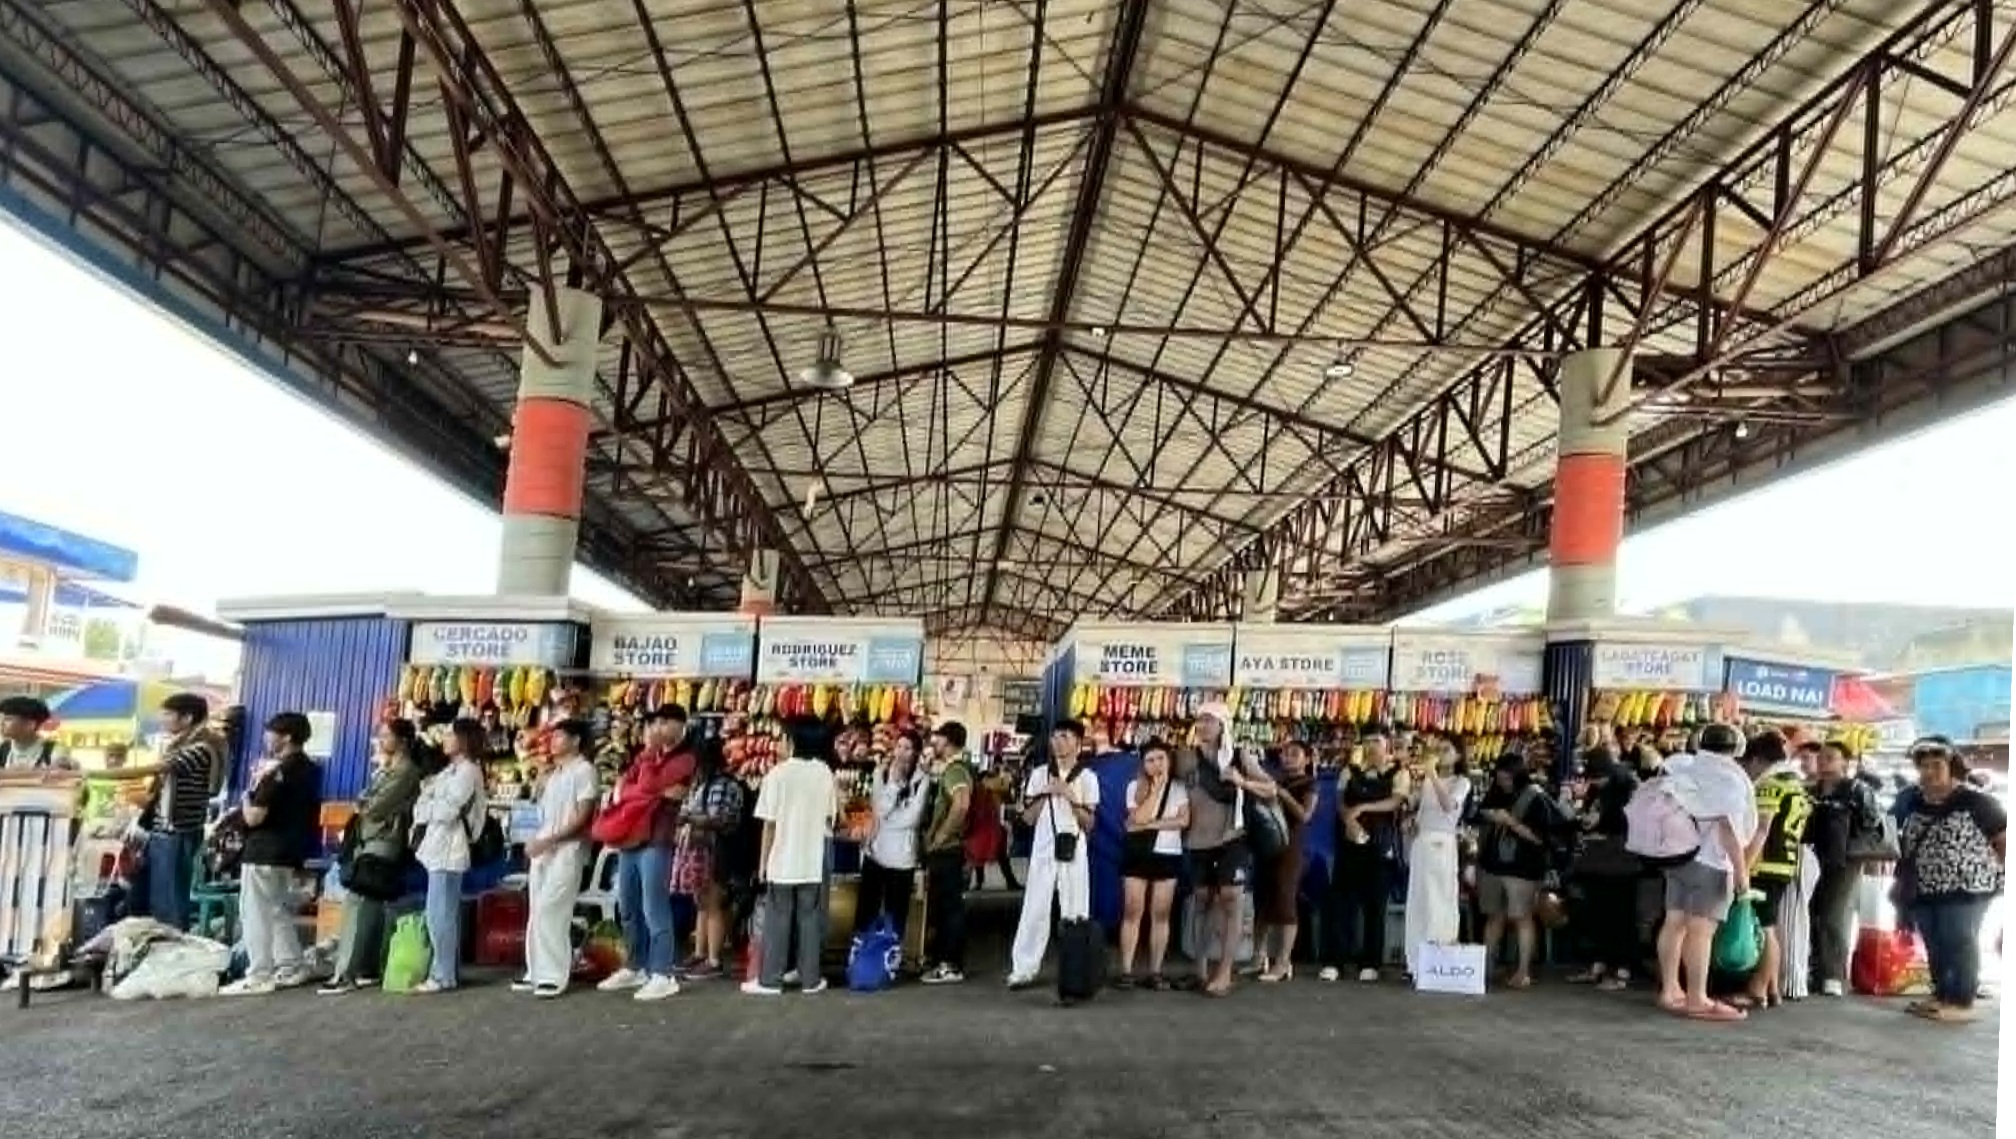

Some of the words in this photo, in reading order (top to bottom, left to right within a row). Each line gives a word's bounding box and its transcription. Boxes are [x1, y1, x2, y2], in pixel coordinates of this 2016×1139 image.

[434, 626, 528, 642] CERCADO
[446, 642, 511, 658] STORE
[771, 643, 858, 656] RODRIGUEZ
[1102, 644, 1157, 658] MEME
[614, 650, 678, 665] STORE
[788, 656, 839, 669] STORE
[1240, 656, 1275, 670] AYA
[1280, 656, 1334, 671] STORE
[1100, 659, 1158, 674] STORE
[1737, 680, 1787, 700] LOAD
[1425, 965, 1475, 978] ALDO
